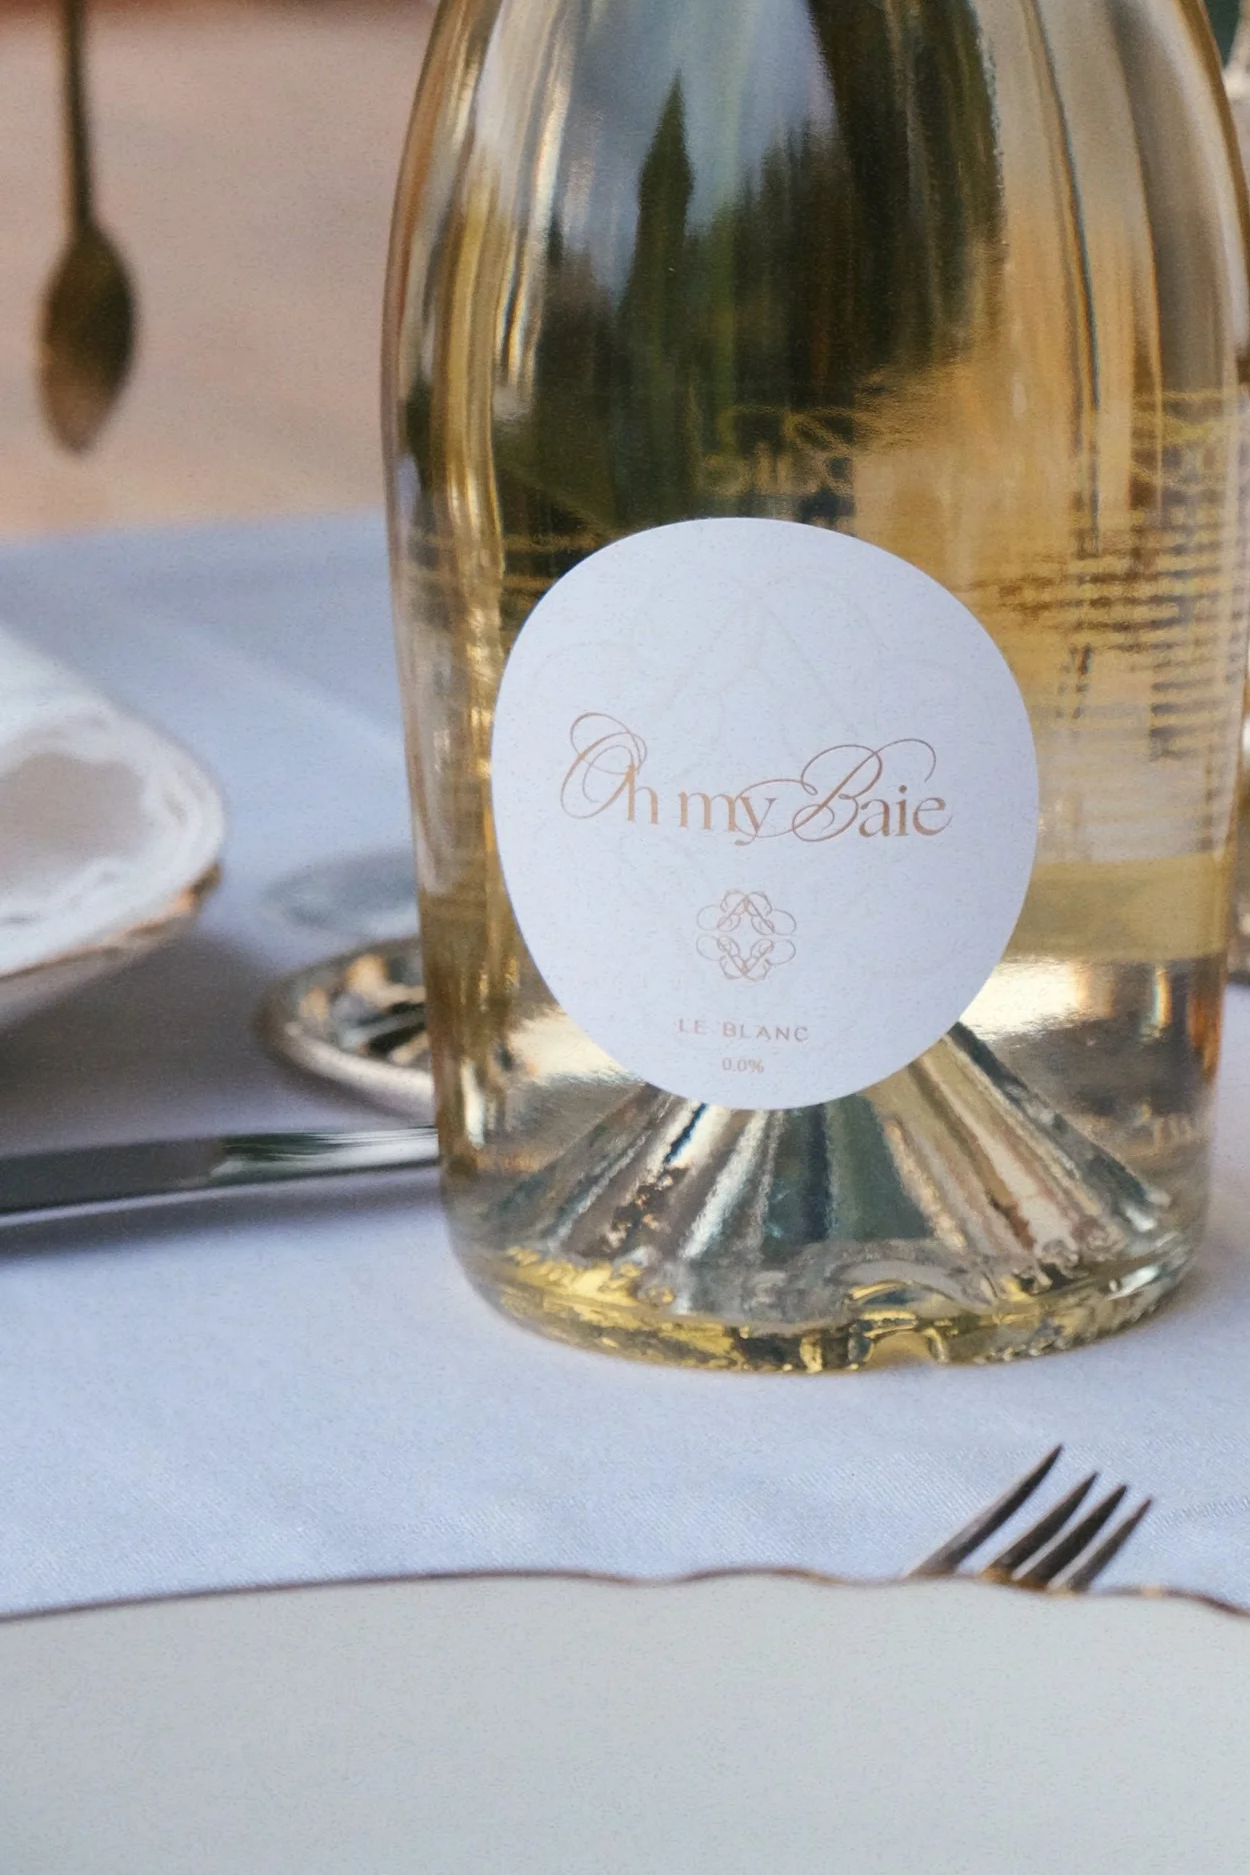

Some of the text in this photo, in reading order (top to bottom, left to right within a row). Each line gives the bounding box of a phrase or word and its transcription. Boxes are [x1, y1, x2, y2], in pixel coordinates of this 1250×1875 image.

[561, 711, 953, 846] Oh my Baie
[677, 1017, 810, 1045] LE BLANC
[721, 1058, 765, 1075] 0.0%
